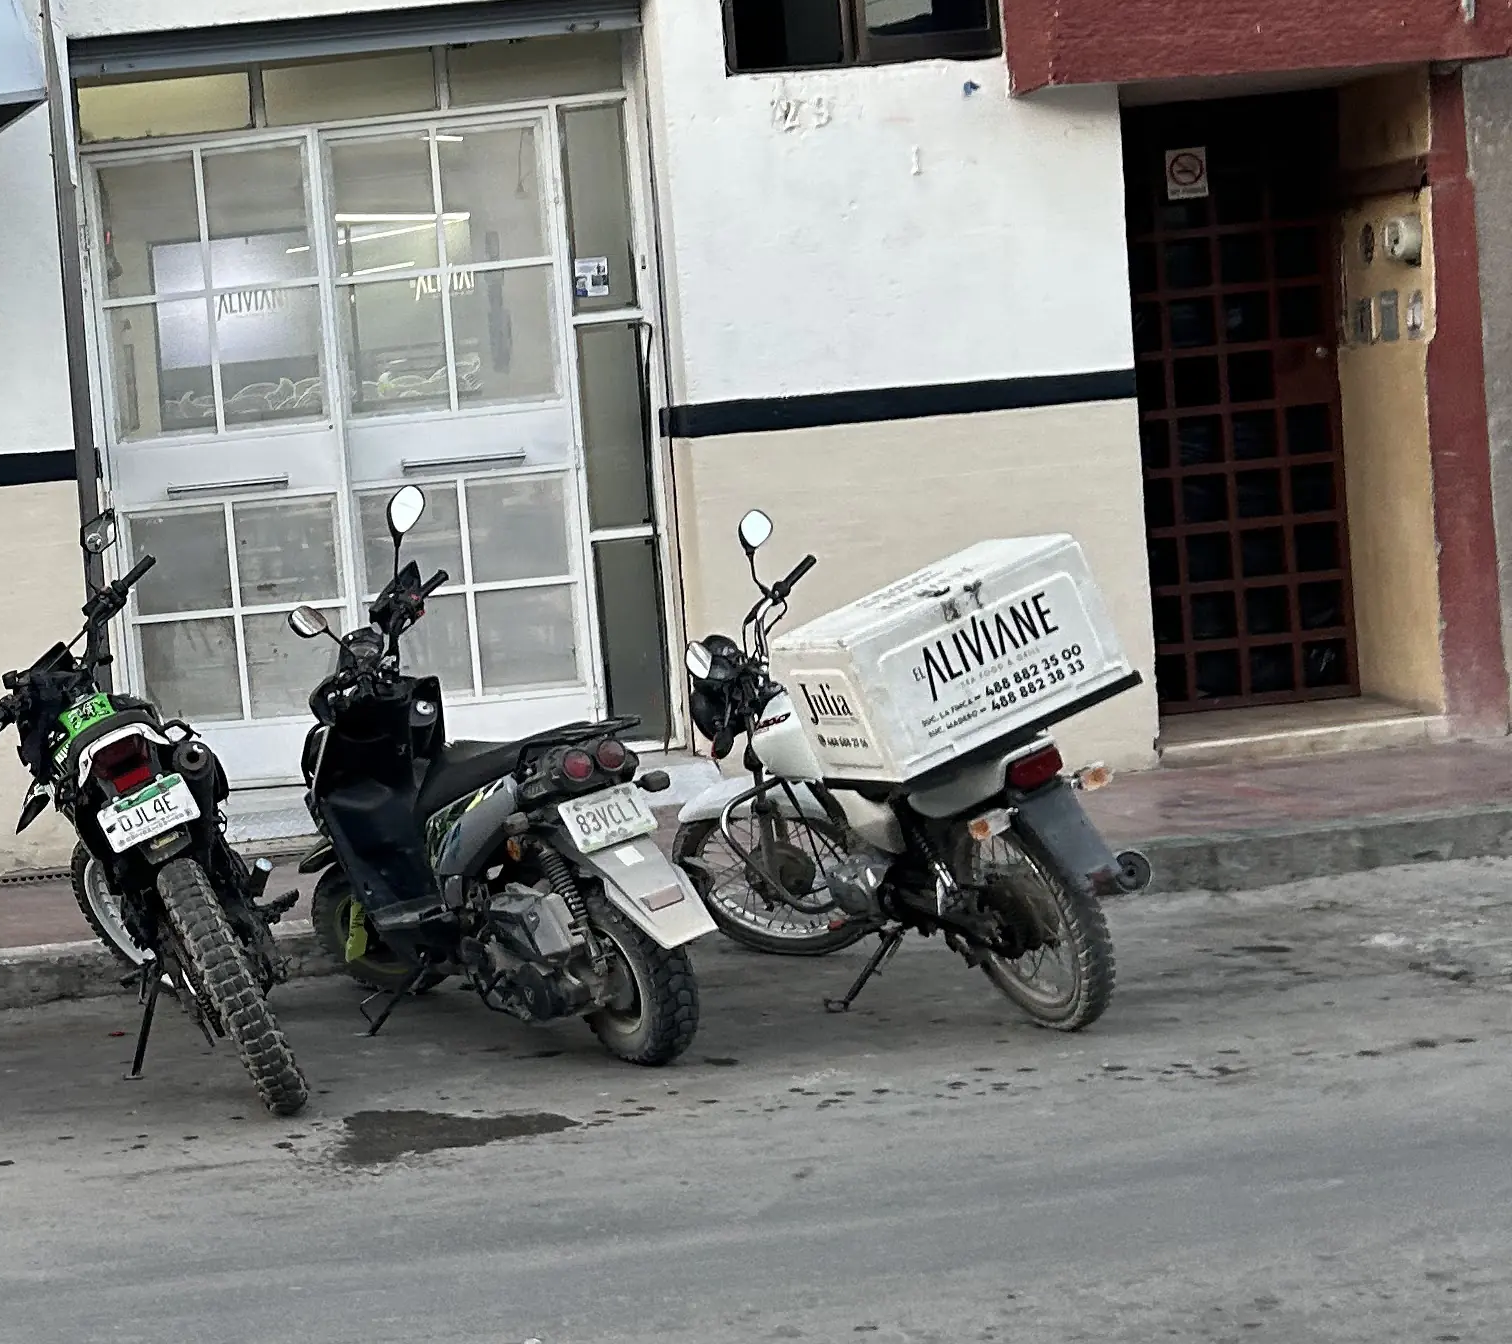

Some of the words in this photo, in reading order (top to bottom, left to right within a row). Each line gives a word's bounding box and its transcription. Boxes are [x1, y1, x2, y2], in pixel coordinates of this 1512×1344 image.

[217, 288, 285, 322] ALIVIAN
[912, 665, 926, 682] EL
[922, 591, 1059, 703] ALIVIANE
[985, 677, 1011, 697] 488
[1013, 663, 1040, 684] 882
[1041, 654, 1060, 671] 35
[1061, 643, 1082, 661] 00
[798, 682, 854, 726] Julia
[990, 691, 1017, 712] 488
[1019, 678, 1046, 698] 882
[1047, 667, 1065, 685] 38
[1067, 658, 1085, 676] 33
